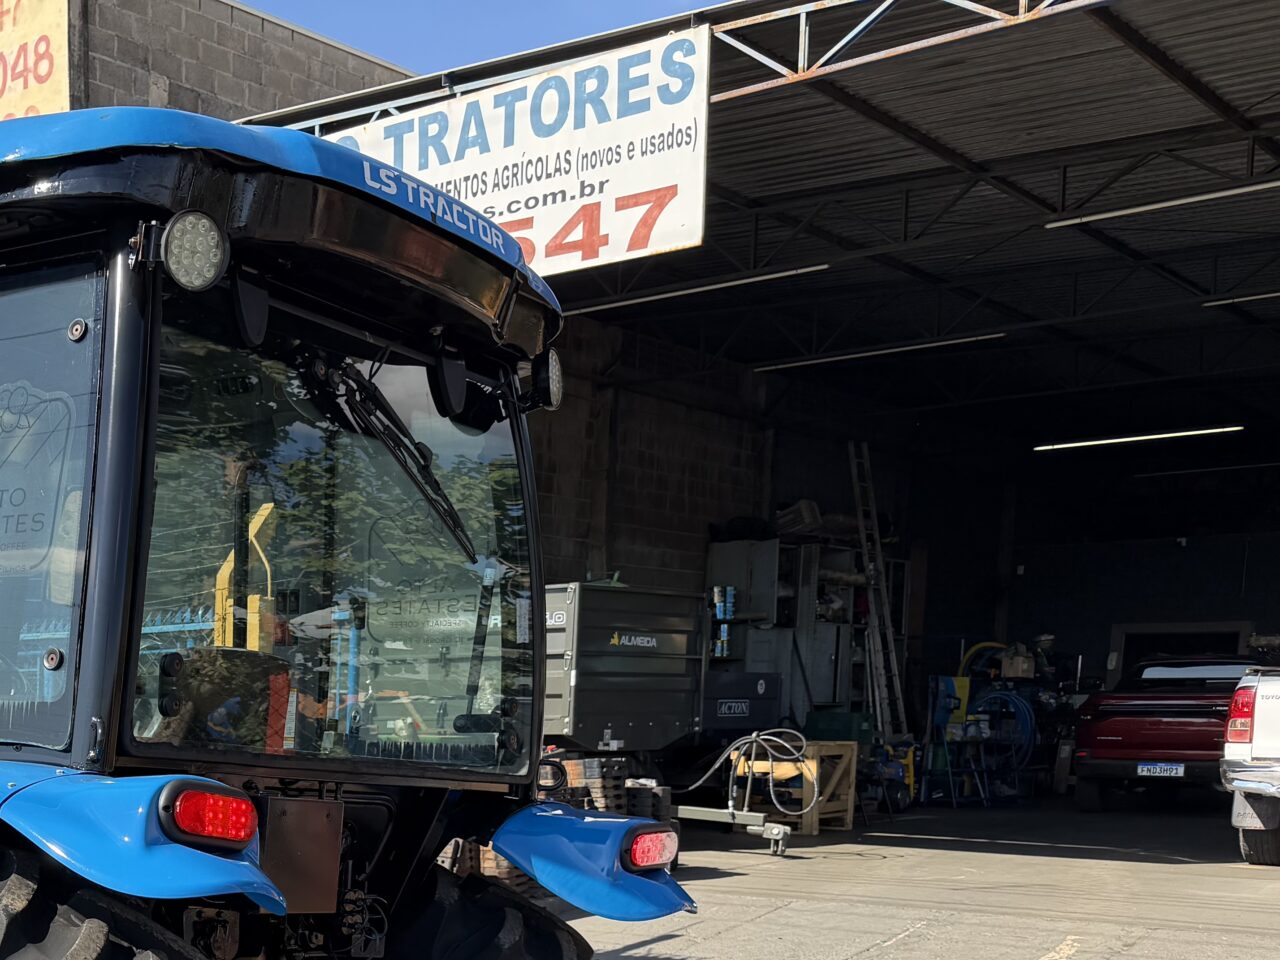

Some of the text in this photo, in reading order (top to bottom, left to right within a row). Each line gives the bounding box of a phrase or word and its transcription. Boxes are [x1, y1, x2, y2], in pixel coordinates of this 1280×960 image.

[383, 38, 697, 171] TRATORES
[492, 150, 572, 193] AGRÍCOLAS
[576, 140, 622, 180] (novos
[627, 140, 635, 160] e
[640, 117, 698, 160] usados)
[363, 161, 505, 255] LS TRACTOR
[483, 176, 610, 219] s.com.br
[620, 635, 657, 648] ALMEIDA
[719, 702, 748, 714] ACTON
[1140, 766, 1179, 776] FND3H91
